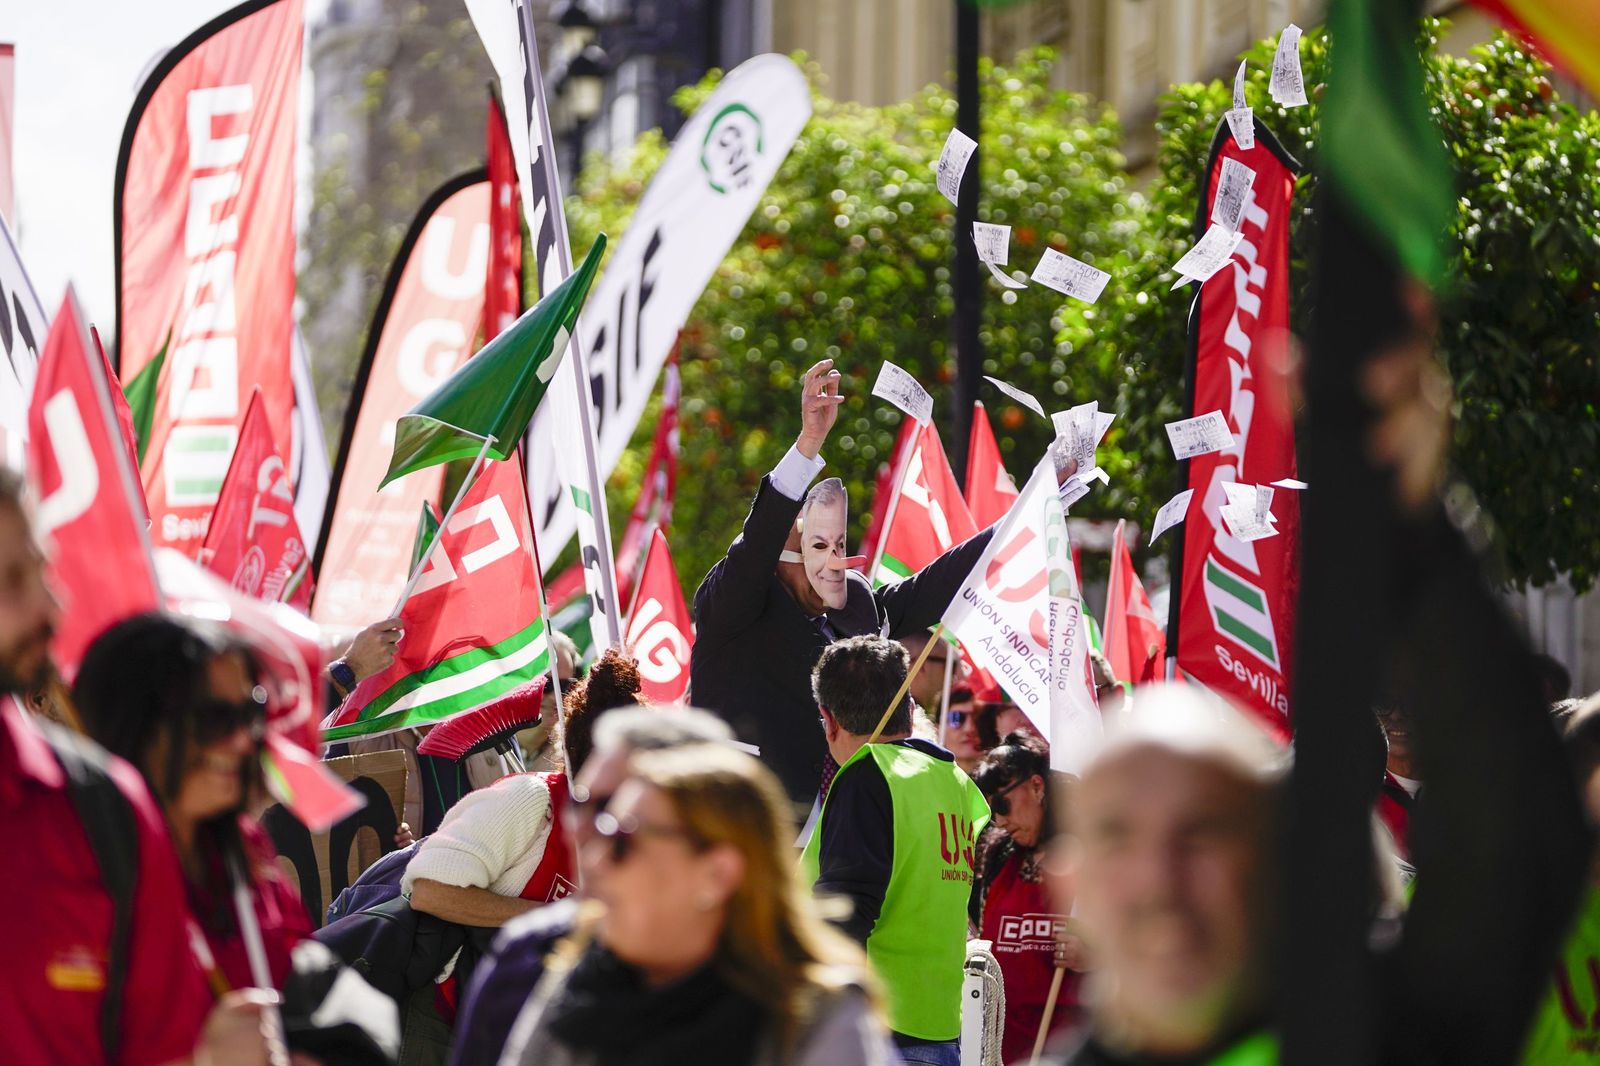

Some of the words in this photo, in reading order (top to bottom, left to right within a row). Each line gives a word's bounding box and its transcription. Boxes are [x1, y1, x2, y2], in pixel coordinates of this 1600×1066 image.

[1078, 265, 1100, 281] 500
[962, 587, 1003, 626] UNIÓN
[1000, 624, 1049, 686] SINDICAL
[978, 635, 1040, 705] Andalucía
[1214, 644, 1289, 717] Sevilla
